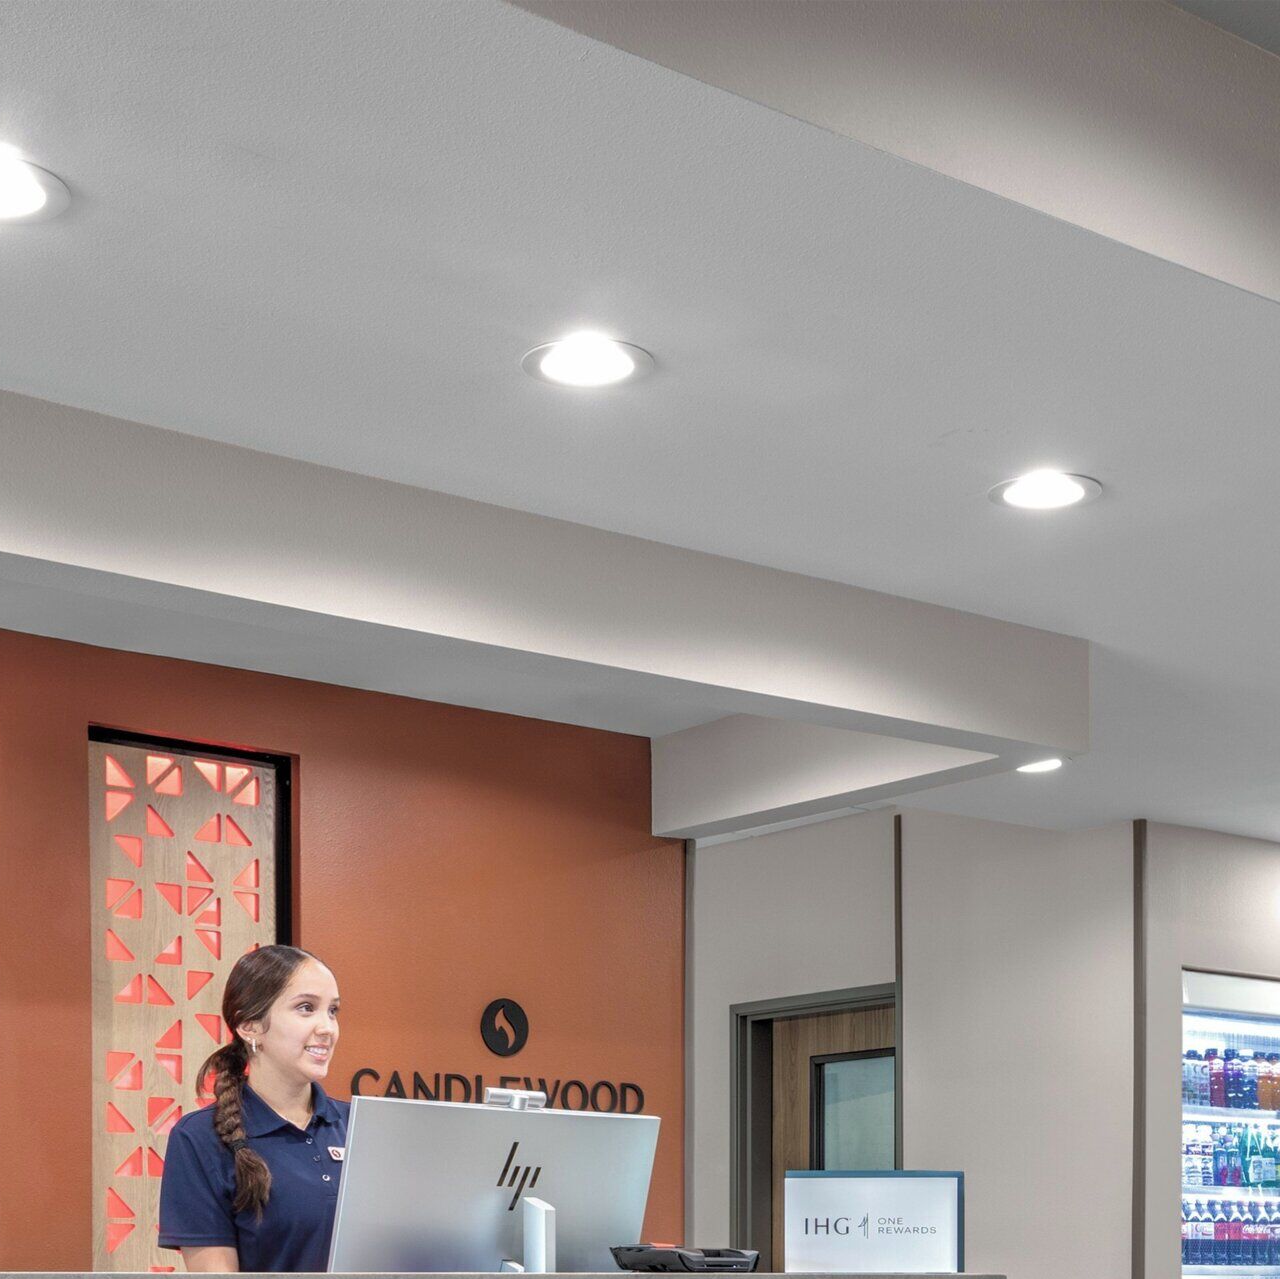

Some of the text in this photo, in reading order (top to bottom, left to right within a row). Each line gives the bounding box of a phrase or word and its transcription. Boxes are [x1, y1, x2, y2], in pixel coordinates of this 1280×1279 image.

[496, 1141, 542, 1211] hp
[804, 1217, 851, 1236] IHG
[877, 1217, 904, 1225] ONE
[877, 1226, 937, 1235] REWARDS
